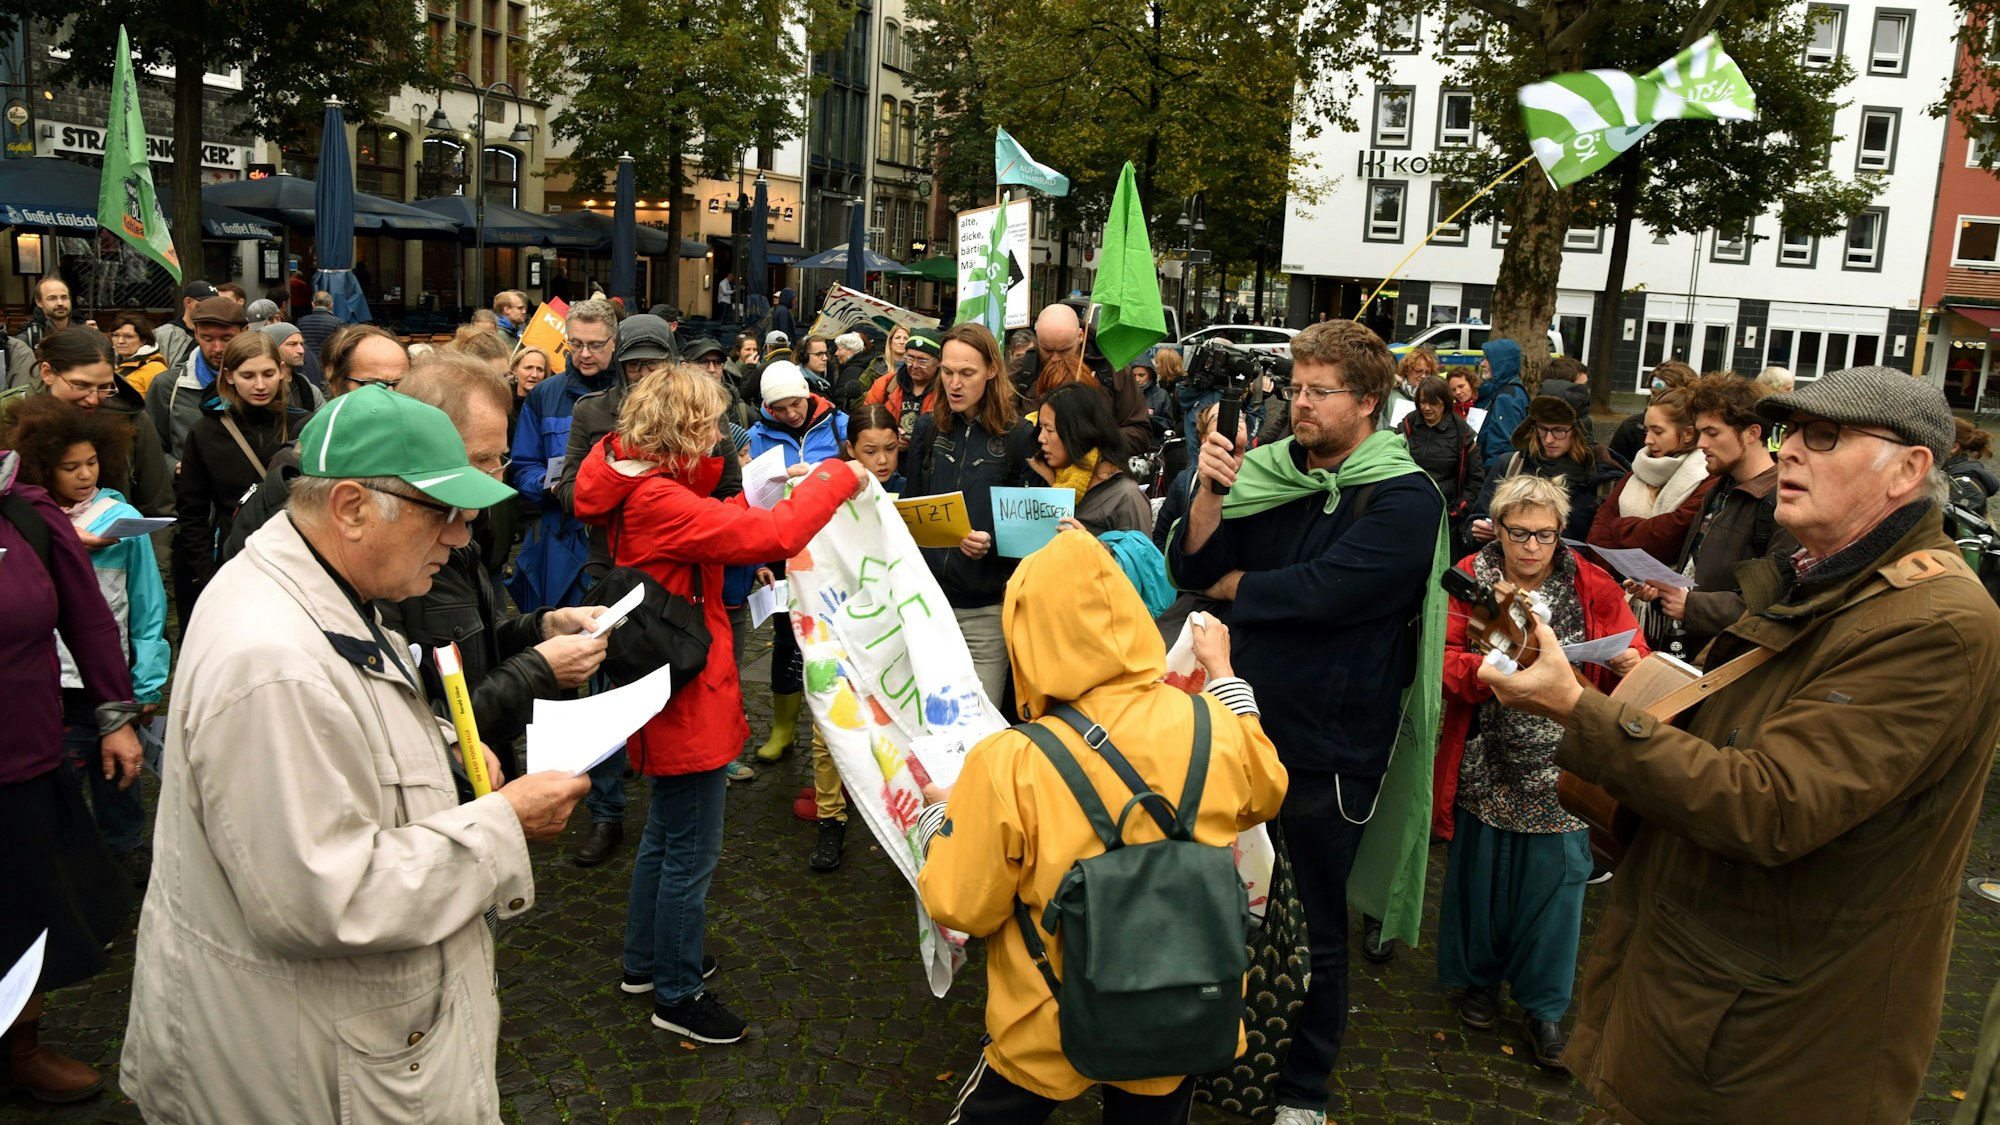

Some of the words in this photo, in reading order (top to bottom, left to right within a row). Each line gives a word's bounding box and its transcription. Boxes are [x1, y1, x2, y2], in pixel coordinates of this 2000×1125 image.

[22, 208, 58, 225] Gaffel
[961, 218, 978, 228] alte,
[961, 231, 984, 242] dicke,
[912, 242, 926, 251] sky
[1000, 498, 1073, 521] NACHBESSERN
[469, 744, 477, 760] FOOD
[473, 760, 481, 772] FAST
